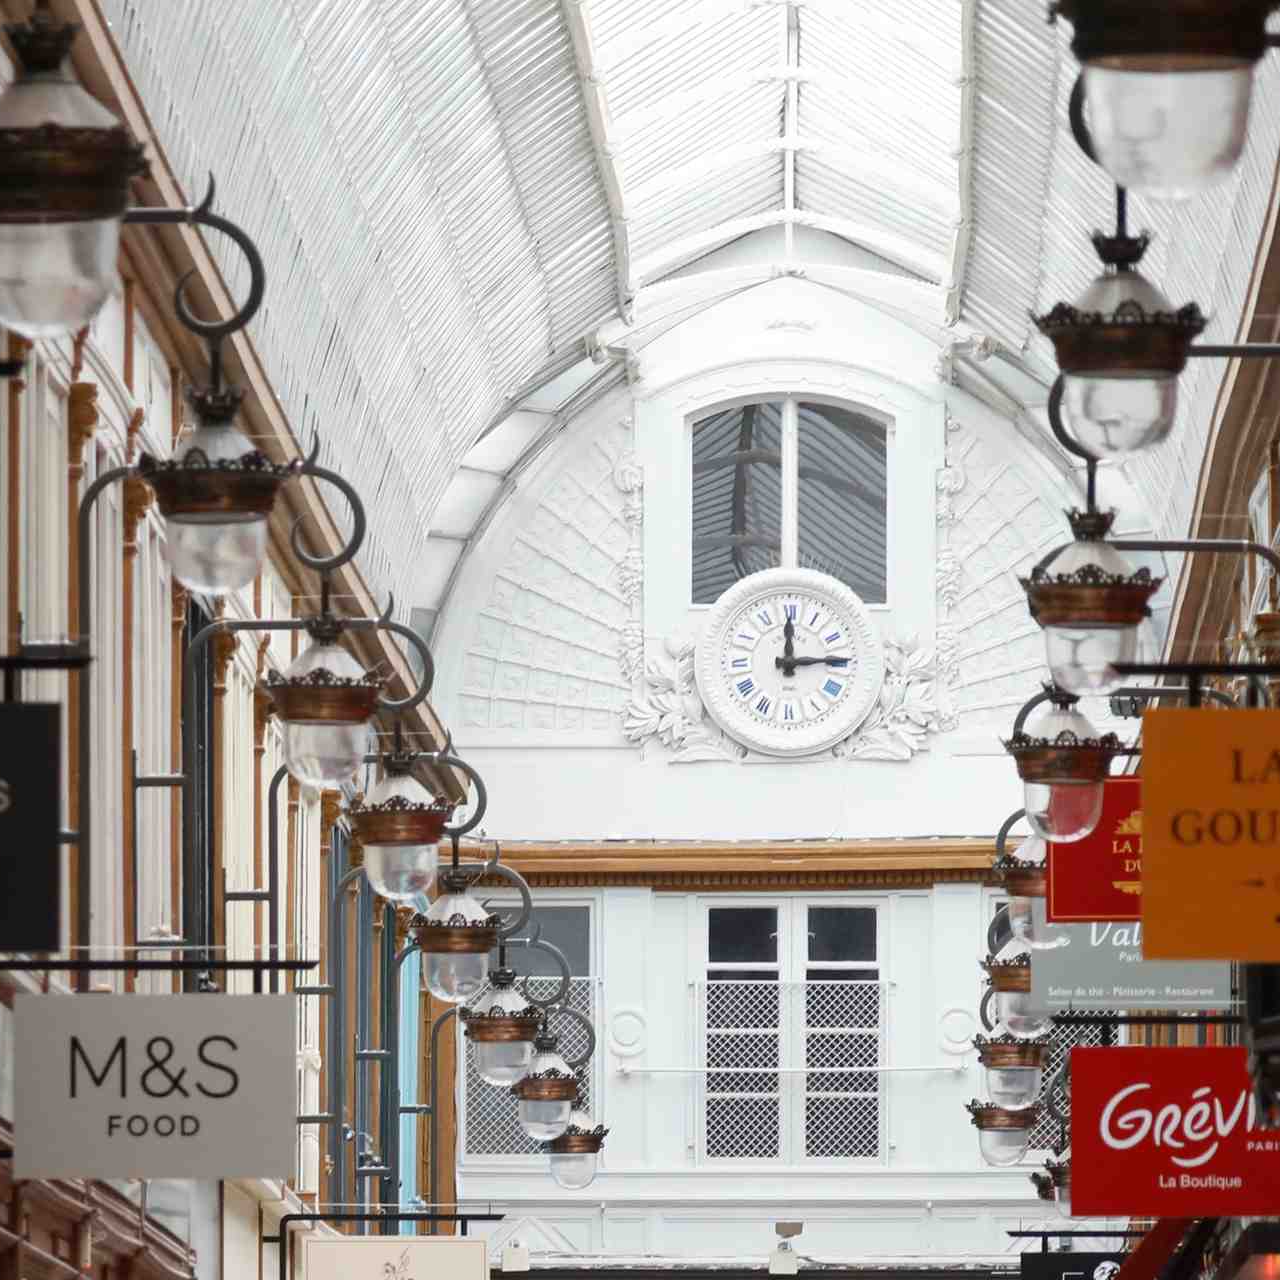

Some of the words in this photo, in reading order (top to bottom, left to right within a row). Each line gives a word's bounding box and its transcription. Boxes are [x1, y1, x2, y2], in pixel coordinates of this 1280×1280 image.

[1112, 839, 1133, 854] LA
[1088, 921, 1143, 948] Val
[67, 1034, 239, 1099] M&S
[106, 1113, 200, 1138] FOOD
[1158, 1174, 1177, 1188] La
[1180, 1174, 1242, 1191] Boutique
